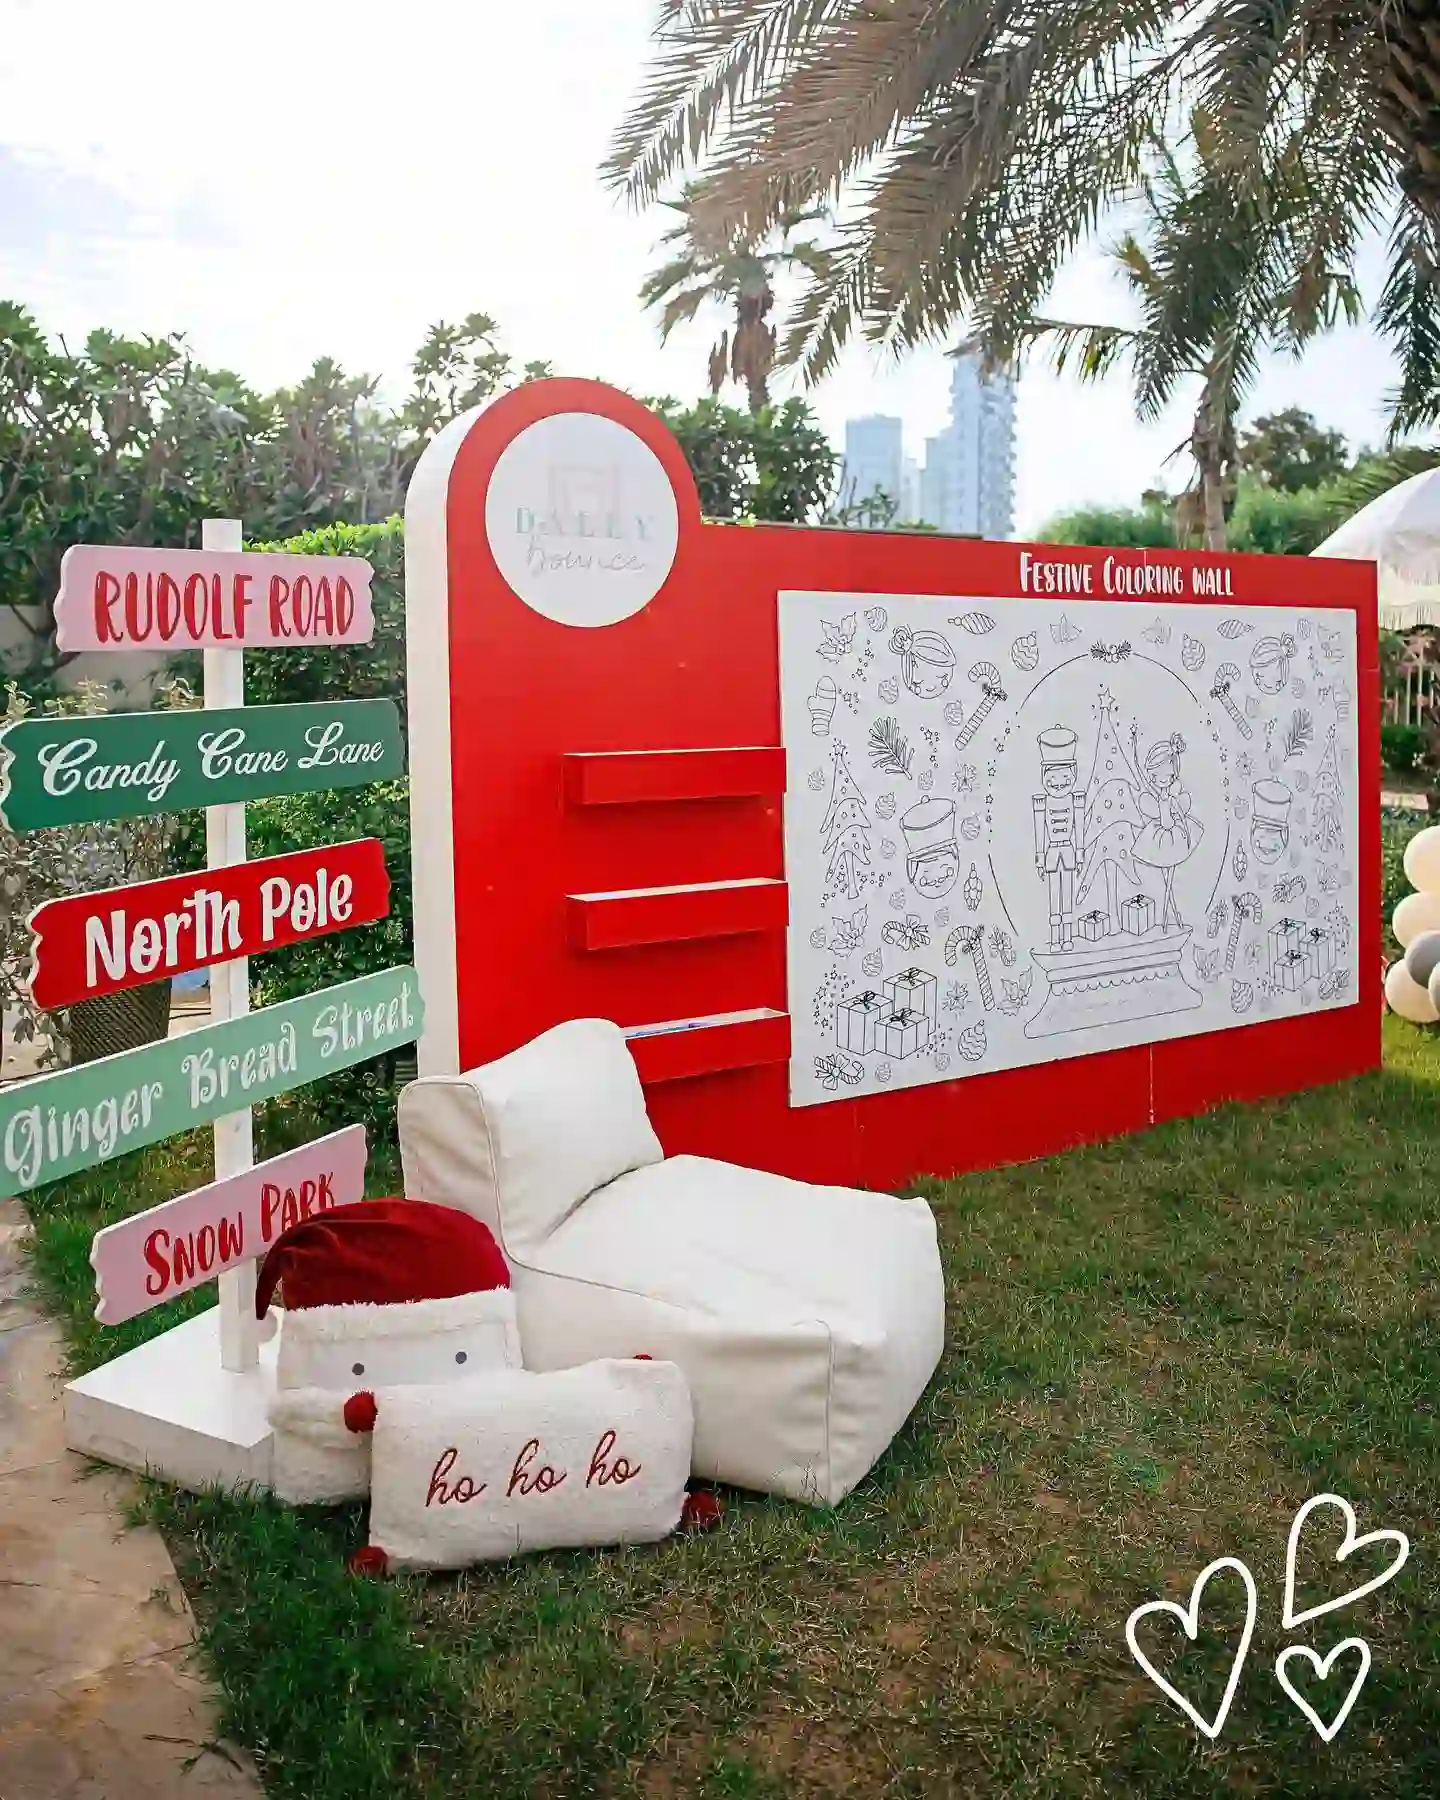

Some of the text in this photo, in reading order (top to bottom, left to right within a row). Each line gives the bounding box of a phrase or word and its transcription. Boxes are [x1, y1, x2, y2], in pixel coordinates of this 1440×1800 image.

[95, 571, 354, 643] RUDOLF ROAD
[37, 721, 384, 802] Candy Cane Lane
[85, 868, 353, 988] North Pole
[4, 982, 414, 1188] Ginger Bread Street
[425, 1429, 642, 1508] ho ho ho
